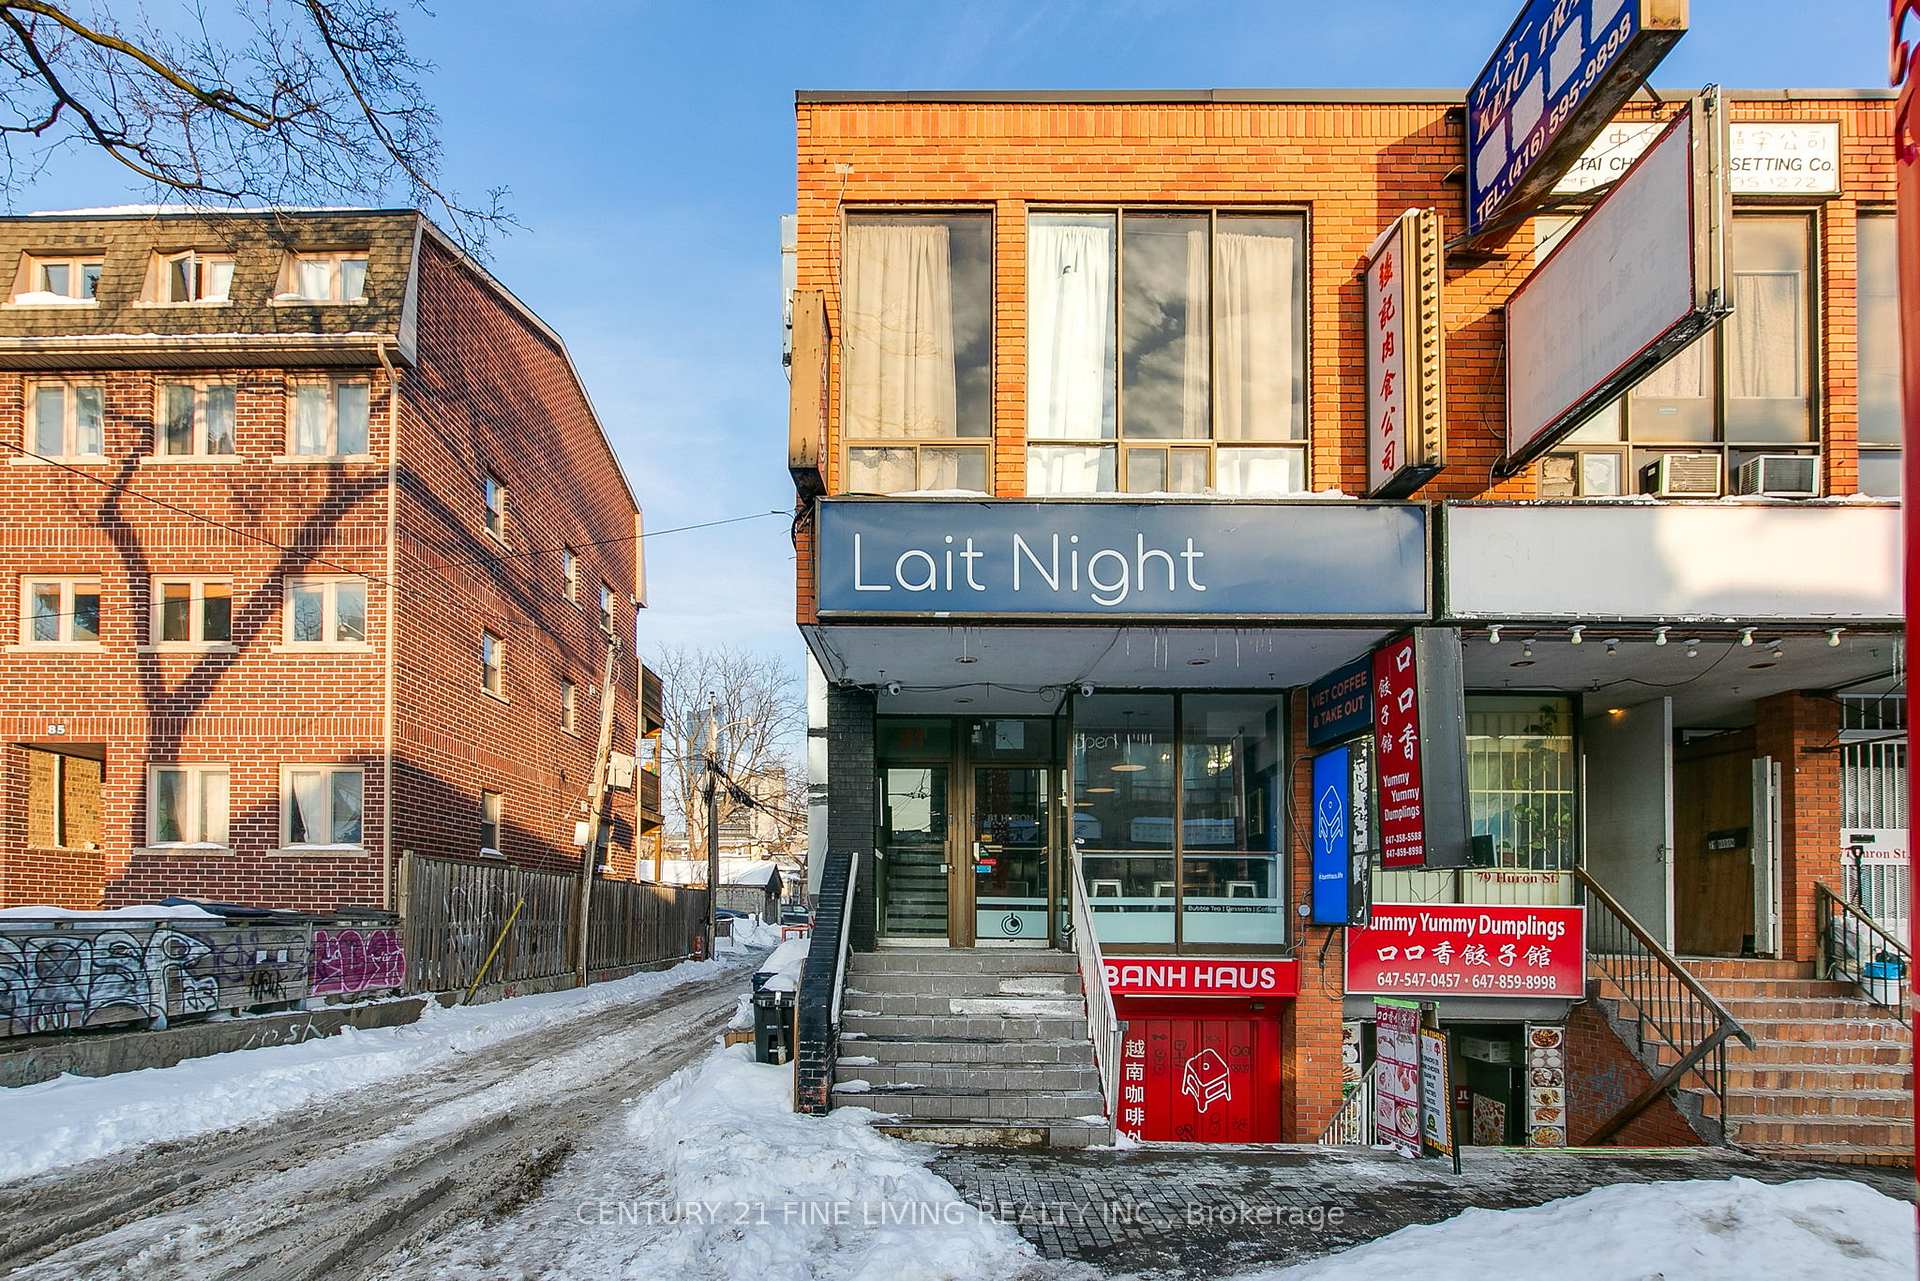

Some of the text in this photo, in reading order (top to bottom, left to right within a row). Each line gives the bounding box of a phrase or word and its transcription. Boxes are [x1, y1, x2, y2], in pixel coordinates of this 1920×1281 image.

[1476, 52, 1529, 145] KEIO
[1476, 12, 1632, 226] TEL: (416) 595-9898
[1580, 157, 1602, 171] TAI
[1609, 157, 1638, 171] CH
[1809, 157, 1835, 171] Co.
[854, 533, 1207, 606] Lait Night
[1311, 671, 1367, 708] VIET COFFEE
[1321, 704, 1343, 725] TAKE
[1344, 694, 1365, 716] OUT
[1396, 646, 1418, 761] 口口香
[47, 724, 65, 735] 85
[1383, 772, 1410, 787] Yummy
[1391, 787, 1420, 802] Yummy
[1384, 805, 1420, 821] Dumplings
[1861, 849, 1890, 858] uron
[1474, 872, 1559, 883] 79 Huron St.
[1369, 913, 1566, 941] ummy Yummy Dumplings
[1376, 940, 1553, 969] 口口香餃子館
[1103, 965, 1276, 989] BANH HAUS
[1376, 971, 1556, 990] 647-547-0457 647-859-8998
